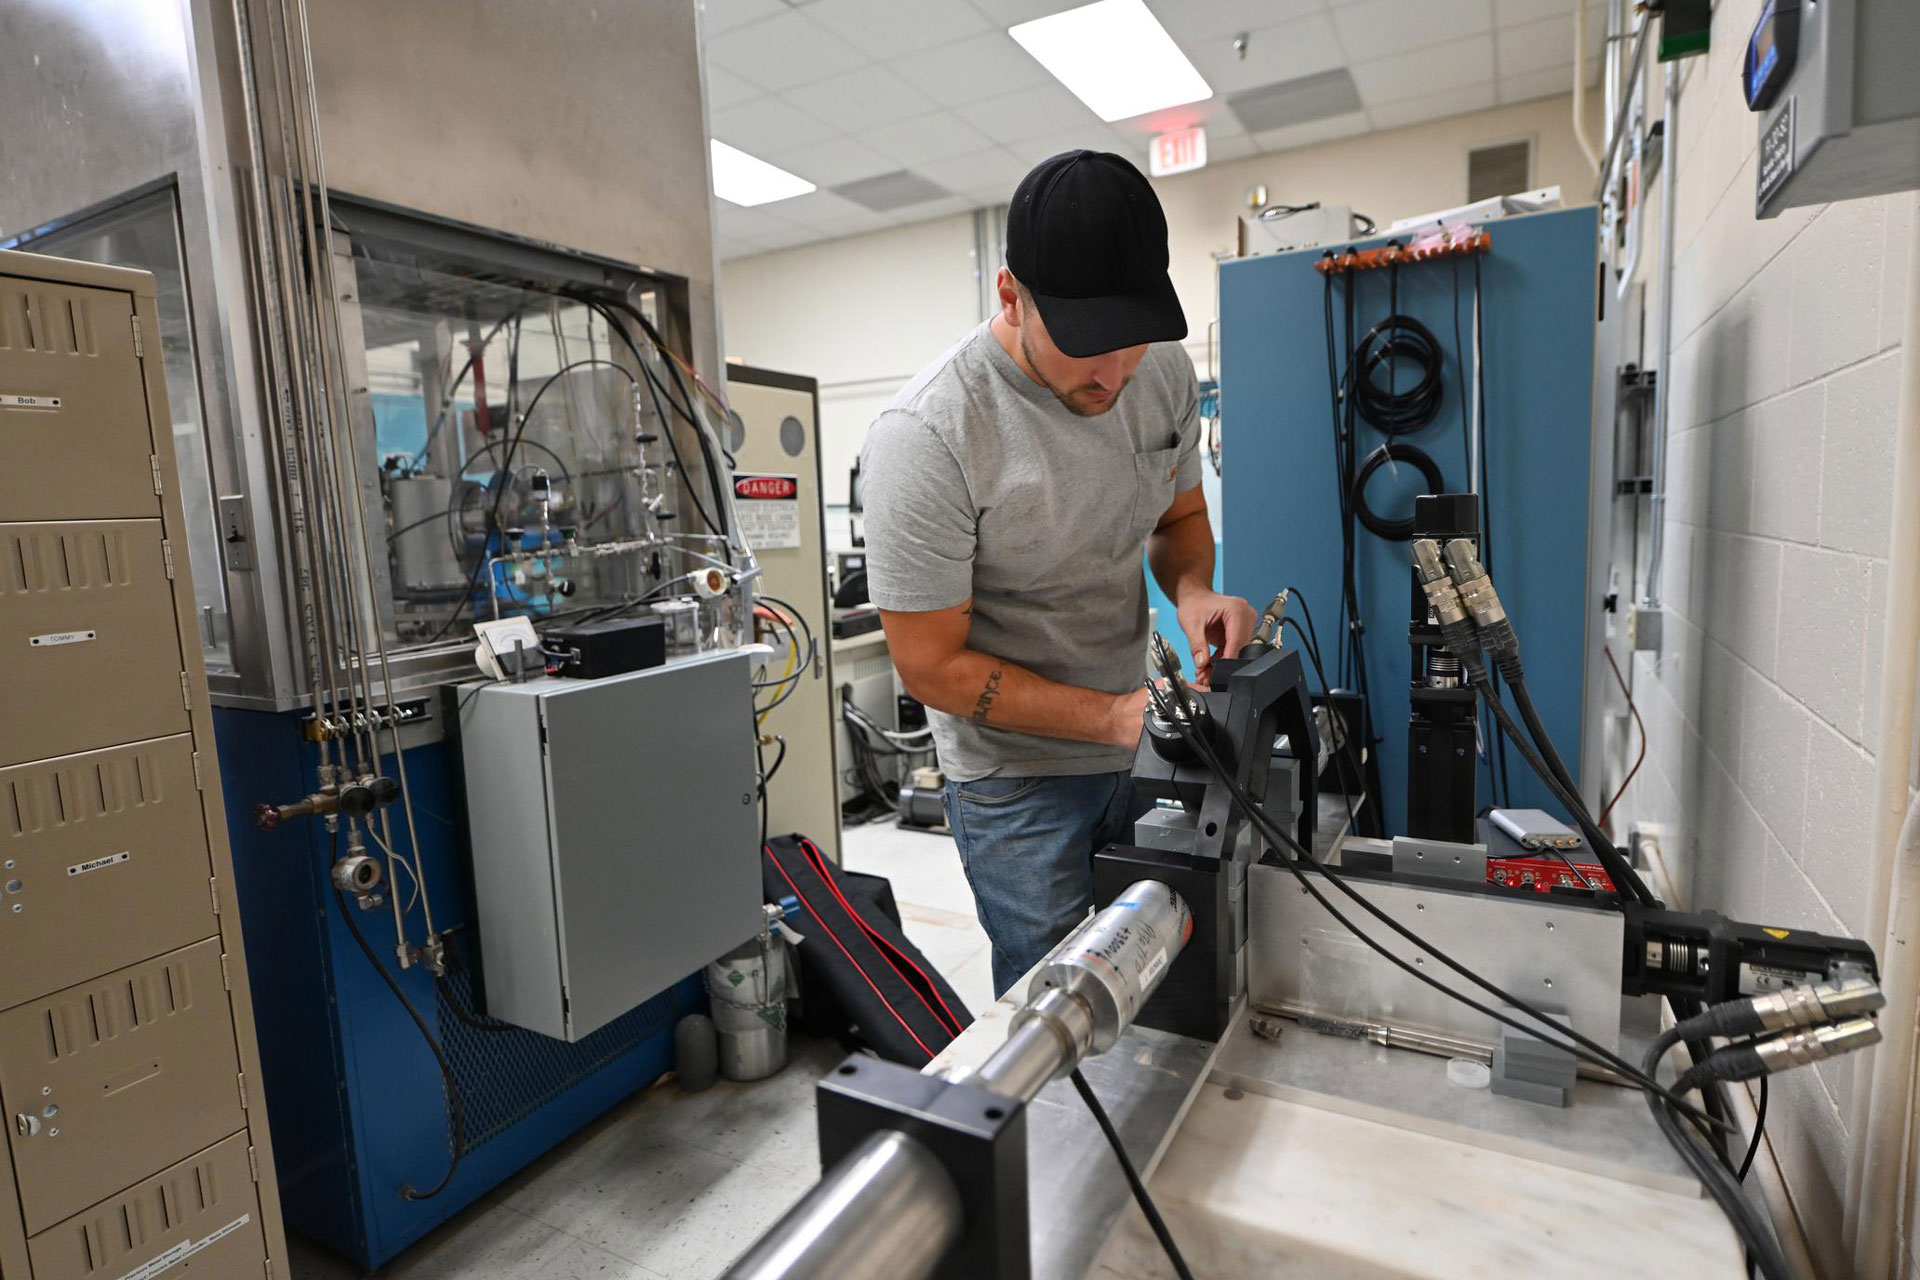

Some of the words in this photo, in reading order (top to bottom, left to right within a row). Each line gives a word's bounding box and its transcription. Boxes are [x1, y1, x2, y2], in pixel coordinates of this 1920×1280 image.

[1158, 130, 1199, 168] EXIT
[743, 480, 790, 495] DANGER
[50, 634, 76, 642] TOMMY
[81, 857, 114, 871] Michael
[148, 1257, 162, 1267] Metal
